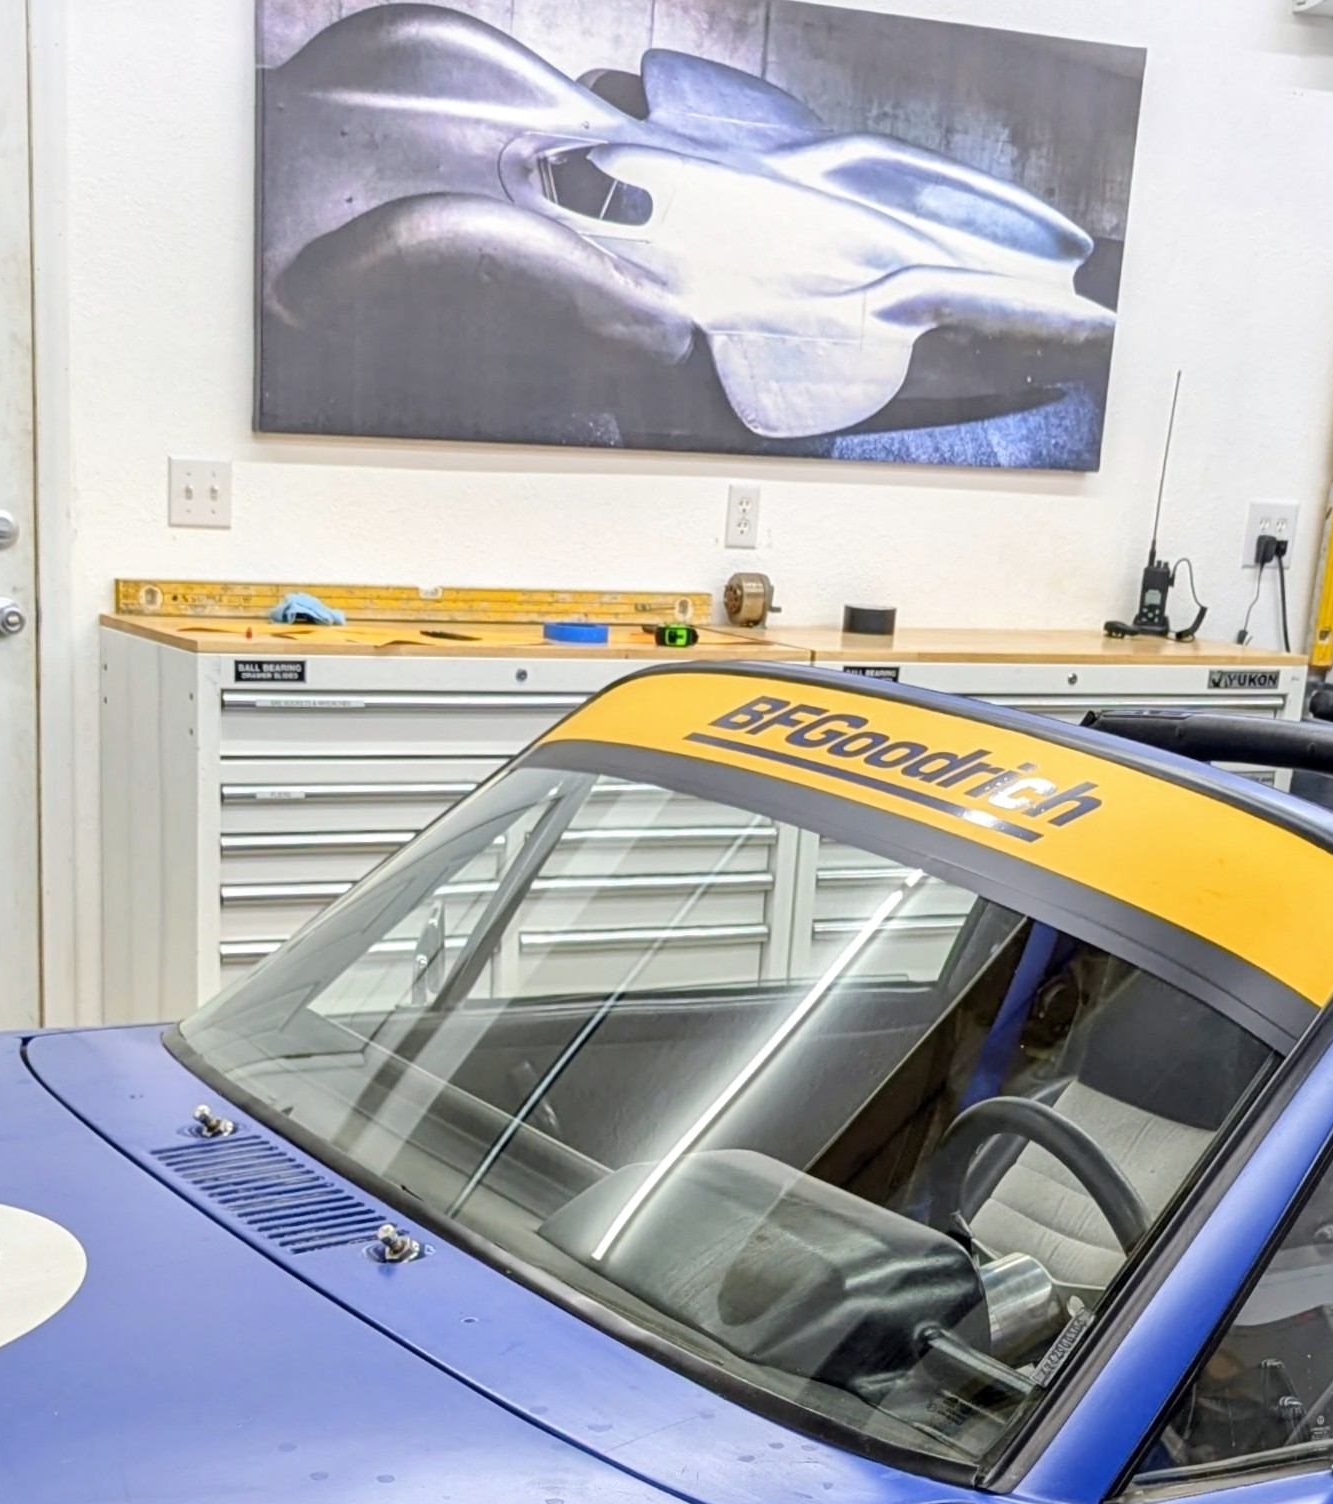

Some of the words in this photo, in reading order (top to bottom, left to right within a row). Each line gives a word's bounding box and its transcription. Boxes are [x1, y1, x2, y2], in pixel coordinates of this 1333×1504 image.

[238, 664, 261, 672] BALL
[263, 664, 302, 672] BEARING
[1228, 674, 1278, 686] YUKON
[708, 695, 1103, 827] BFGoodrich
